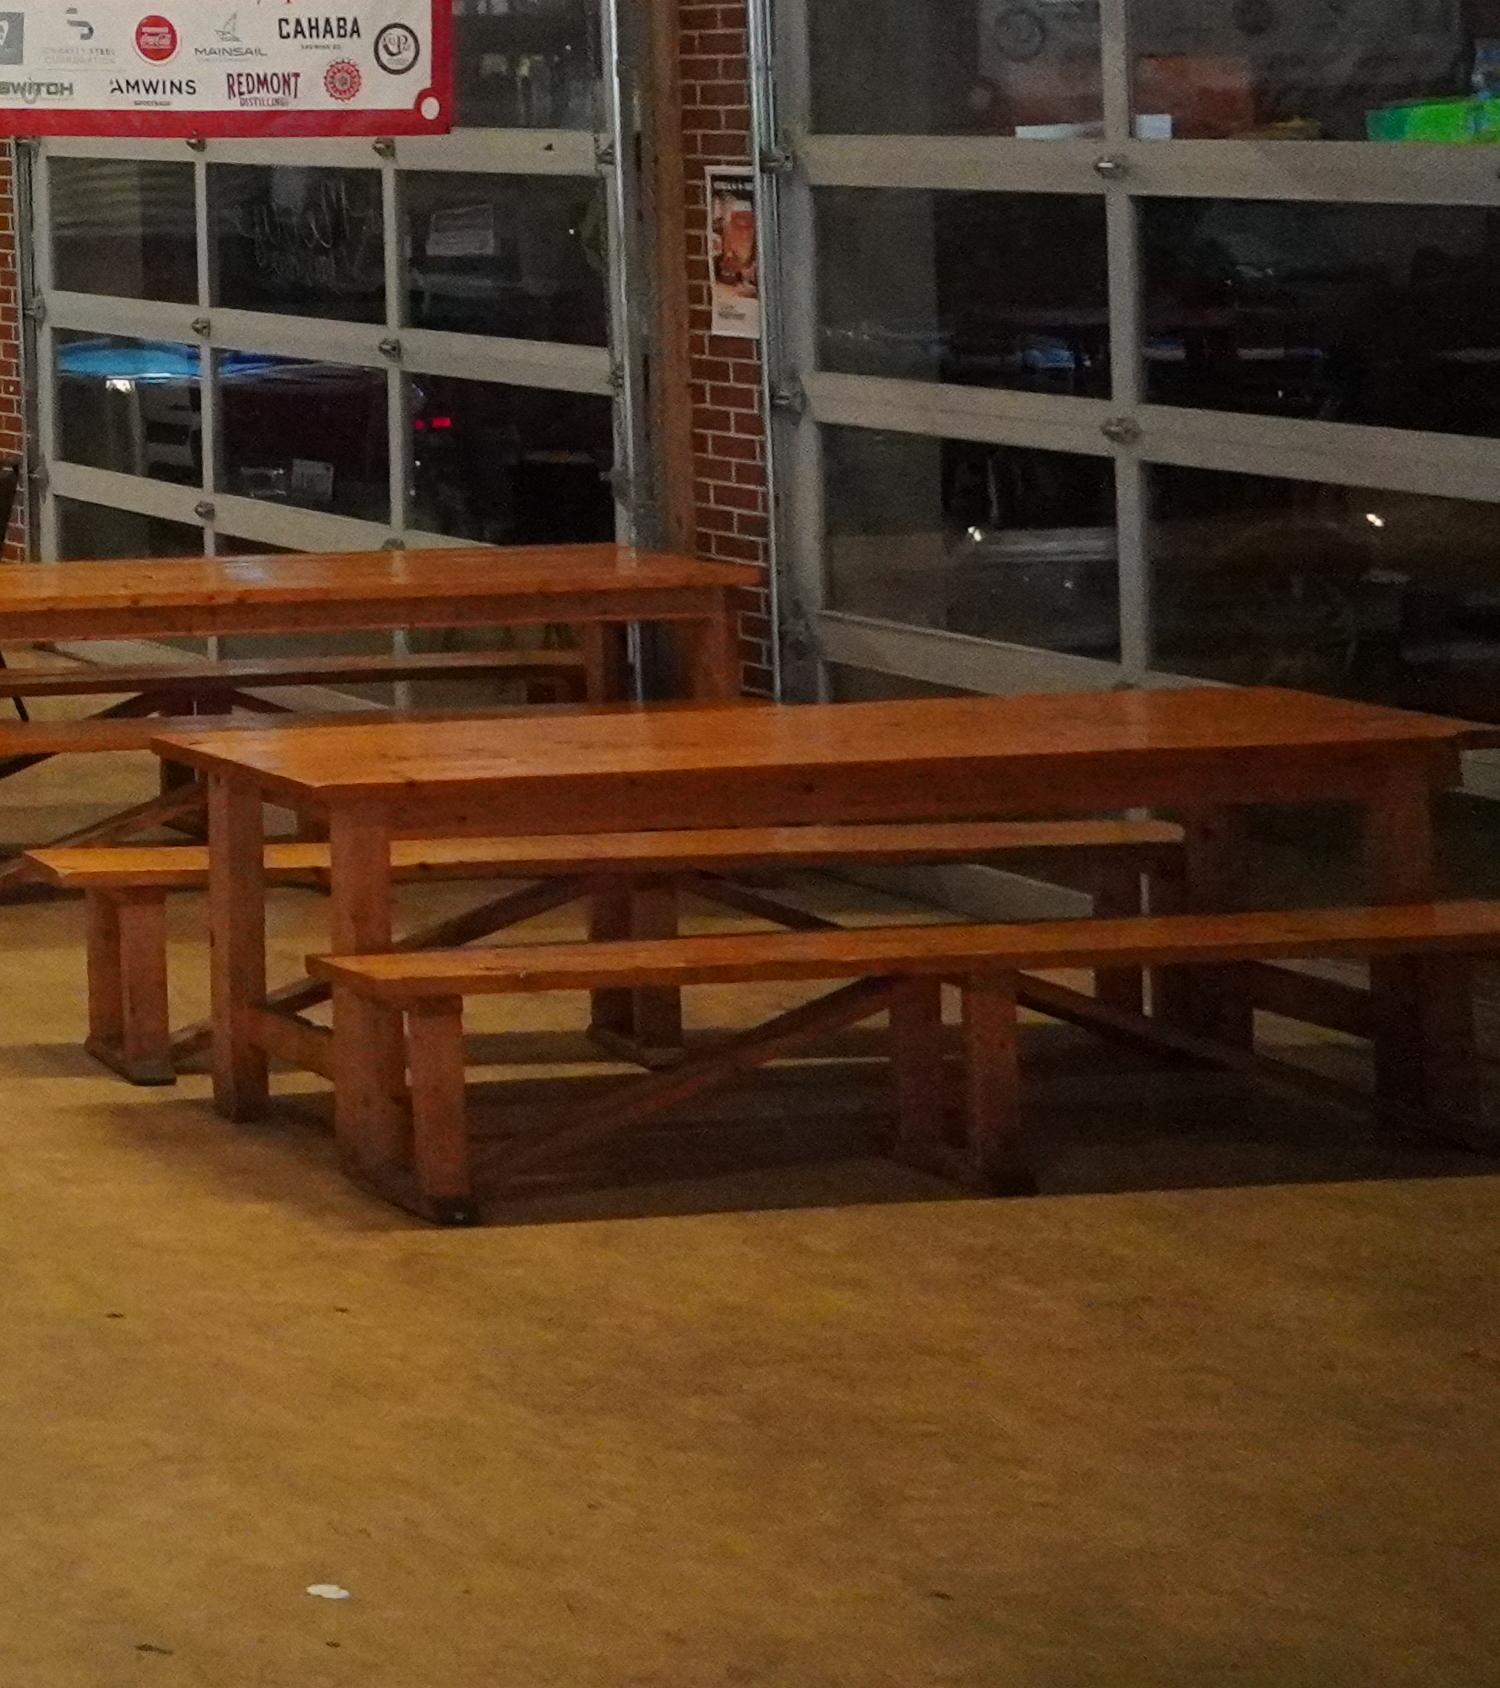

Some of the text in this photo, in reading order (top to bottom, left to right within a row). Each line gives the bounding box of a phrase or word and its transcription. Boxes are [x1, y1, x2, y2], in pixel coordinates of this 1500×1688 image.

[278, 16, 361, 39] CAHABA
[194, 47, 268, 57] MAINSAIL
[110, 79, 197, 95] AMWINS
[226, 71, 301, 100] REDMONT
